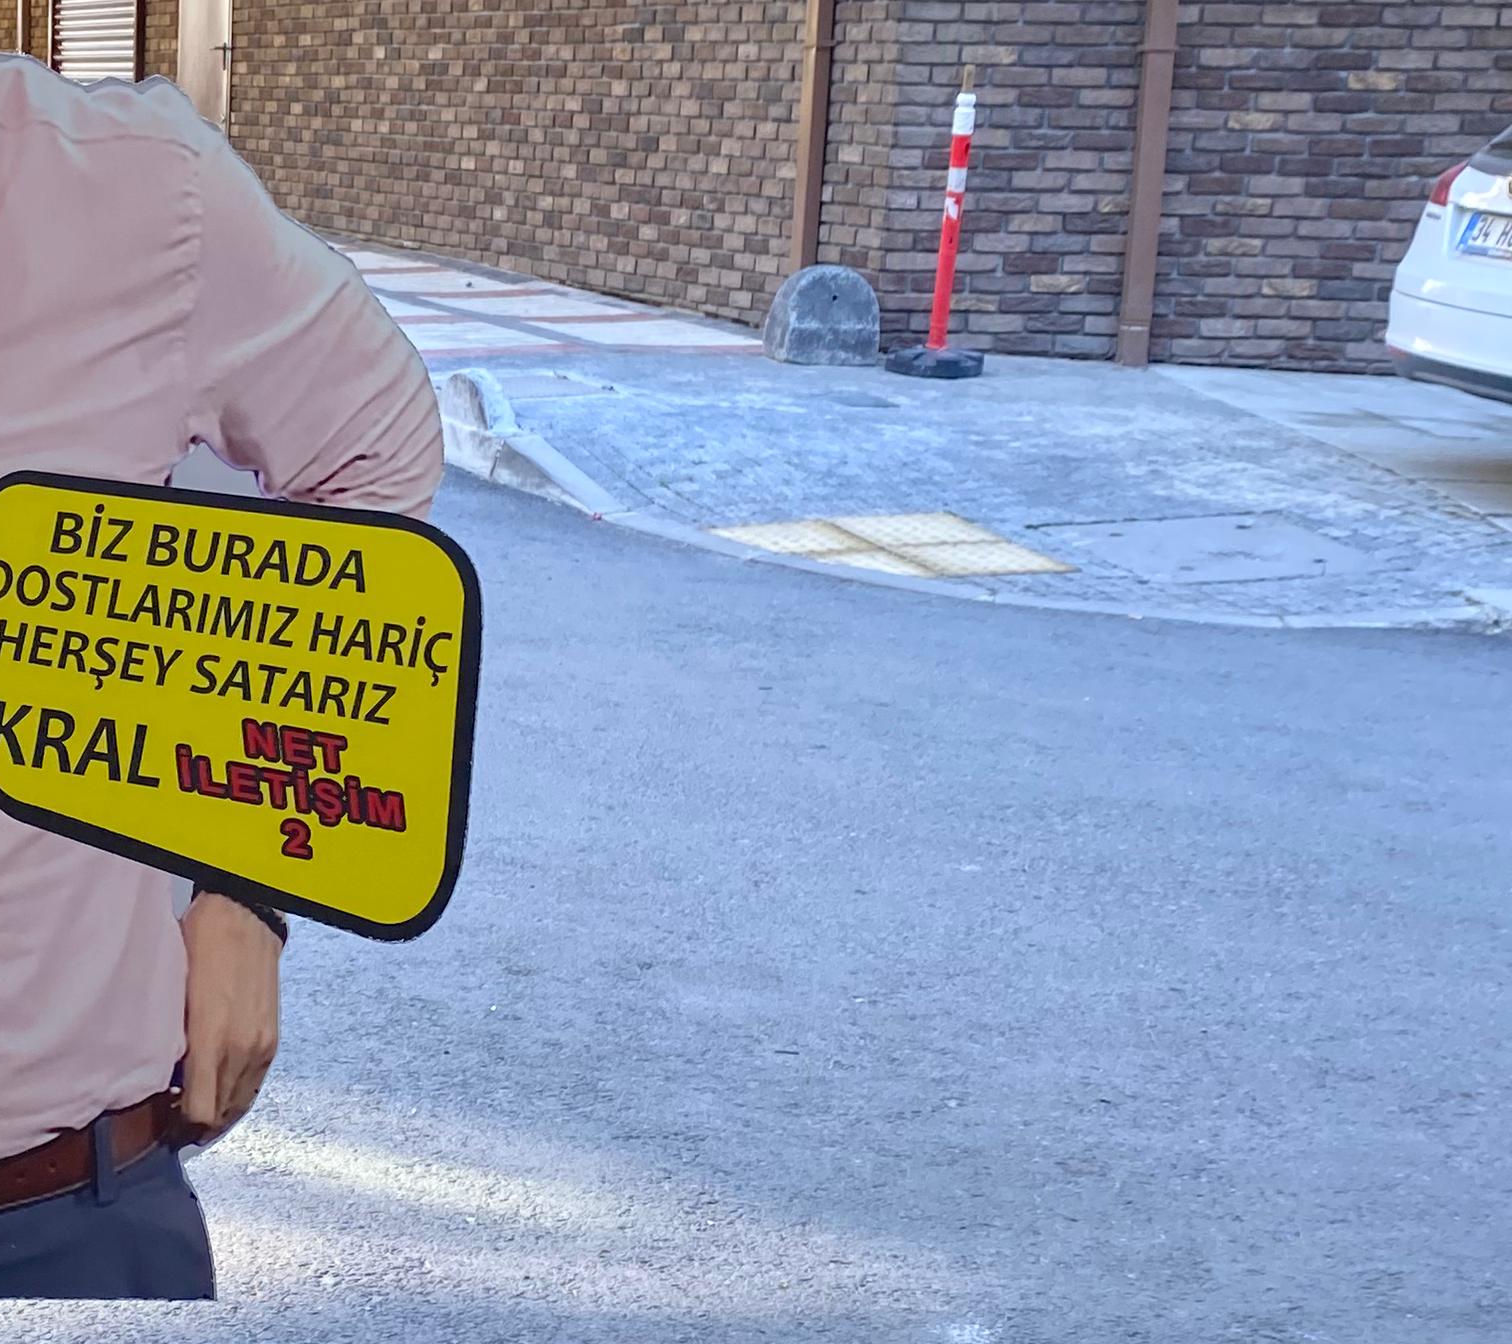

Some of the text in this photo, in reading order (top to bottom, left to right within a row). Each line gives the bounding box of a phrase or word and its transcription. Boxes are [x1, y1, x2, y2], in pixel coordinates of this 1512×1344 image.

[1471, 216, 1495, 243] 34
[50, 503, 366, 594] BİZ BURADA
[309, 611, 453, 687] HARİÇ
[189, 654, 397, 725] SATARIZ
[242, 719, 347, 773] NET
[175, 744, 406, 831] İLETİŞİM
[281, 816, 313, 859] 2
